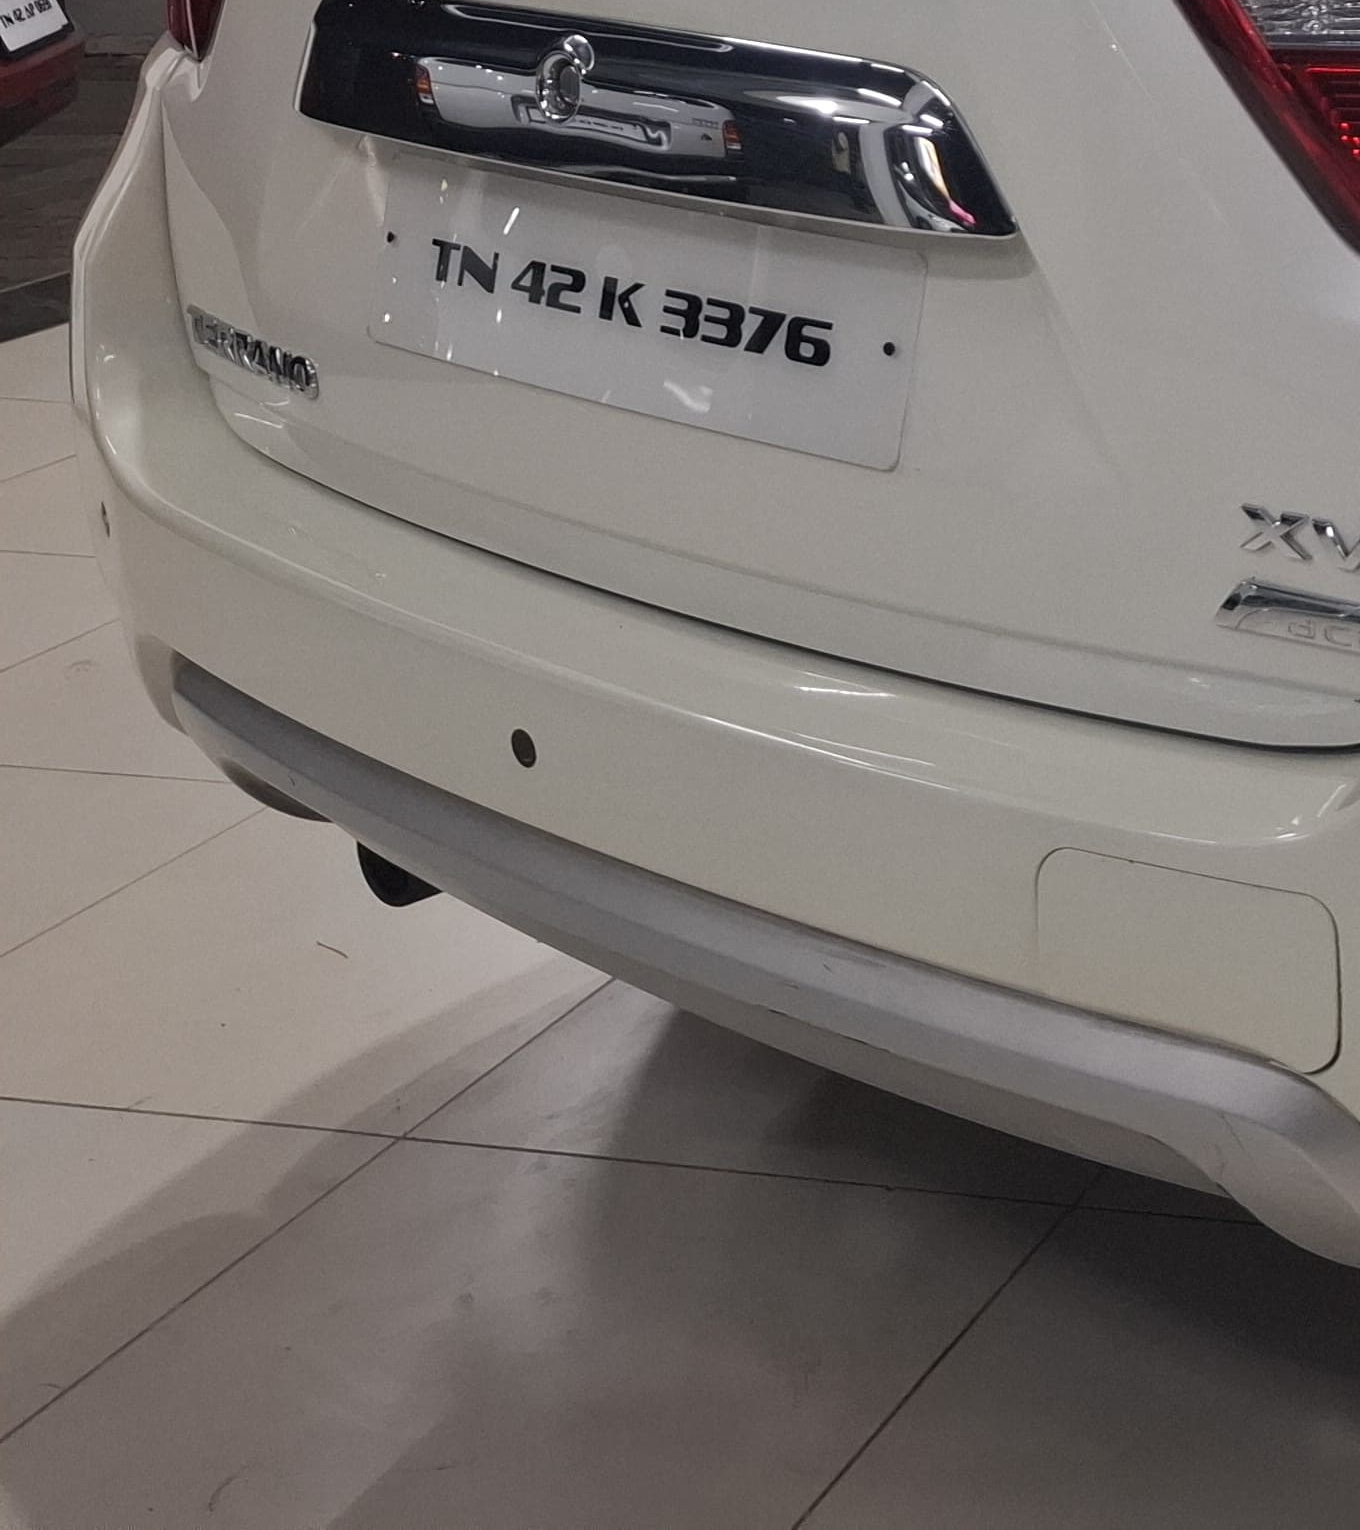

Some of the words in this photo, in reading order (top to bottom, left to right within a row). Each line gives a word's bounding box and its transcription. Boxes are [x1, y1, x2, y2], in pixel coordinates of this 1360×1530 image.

[186, 303, 320, 401] TERRANO
[430, 236, 499, 296] TN
[510, 259, 588, 315] 42
[598, 278, 647, 330] K
[659, 289, 834, 369] 3376
